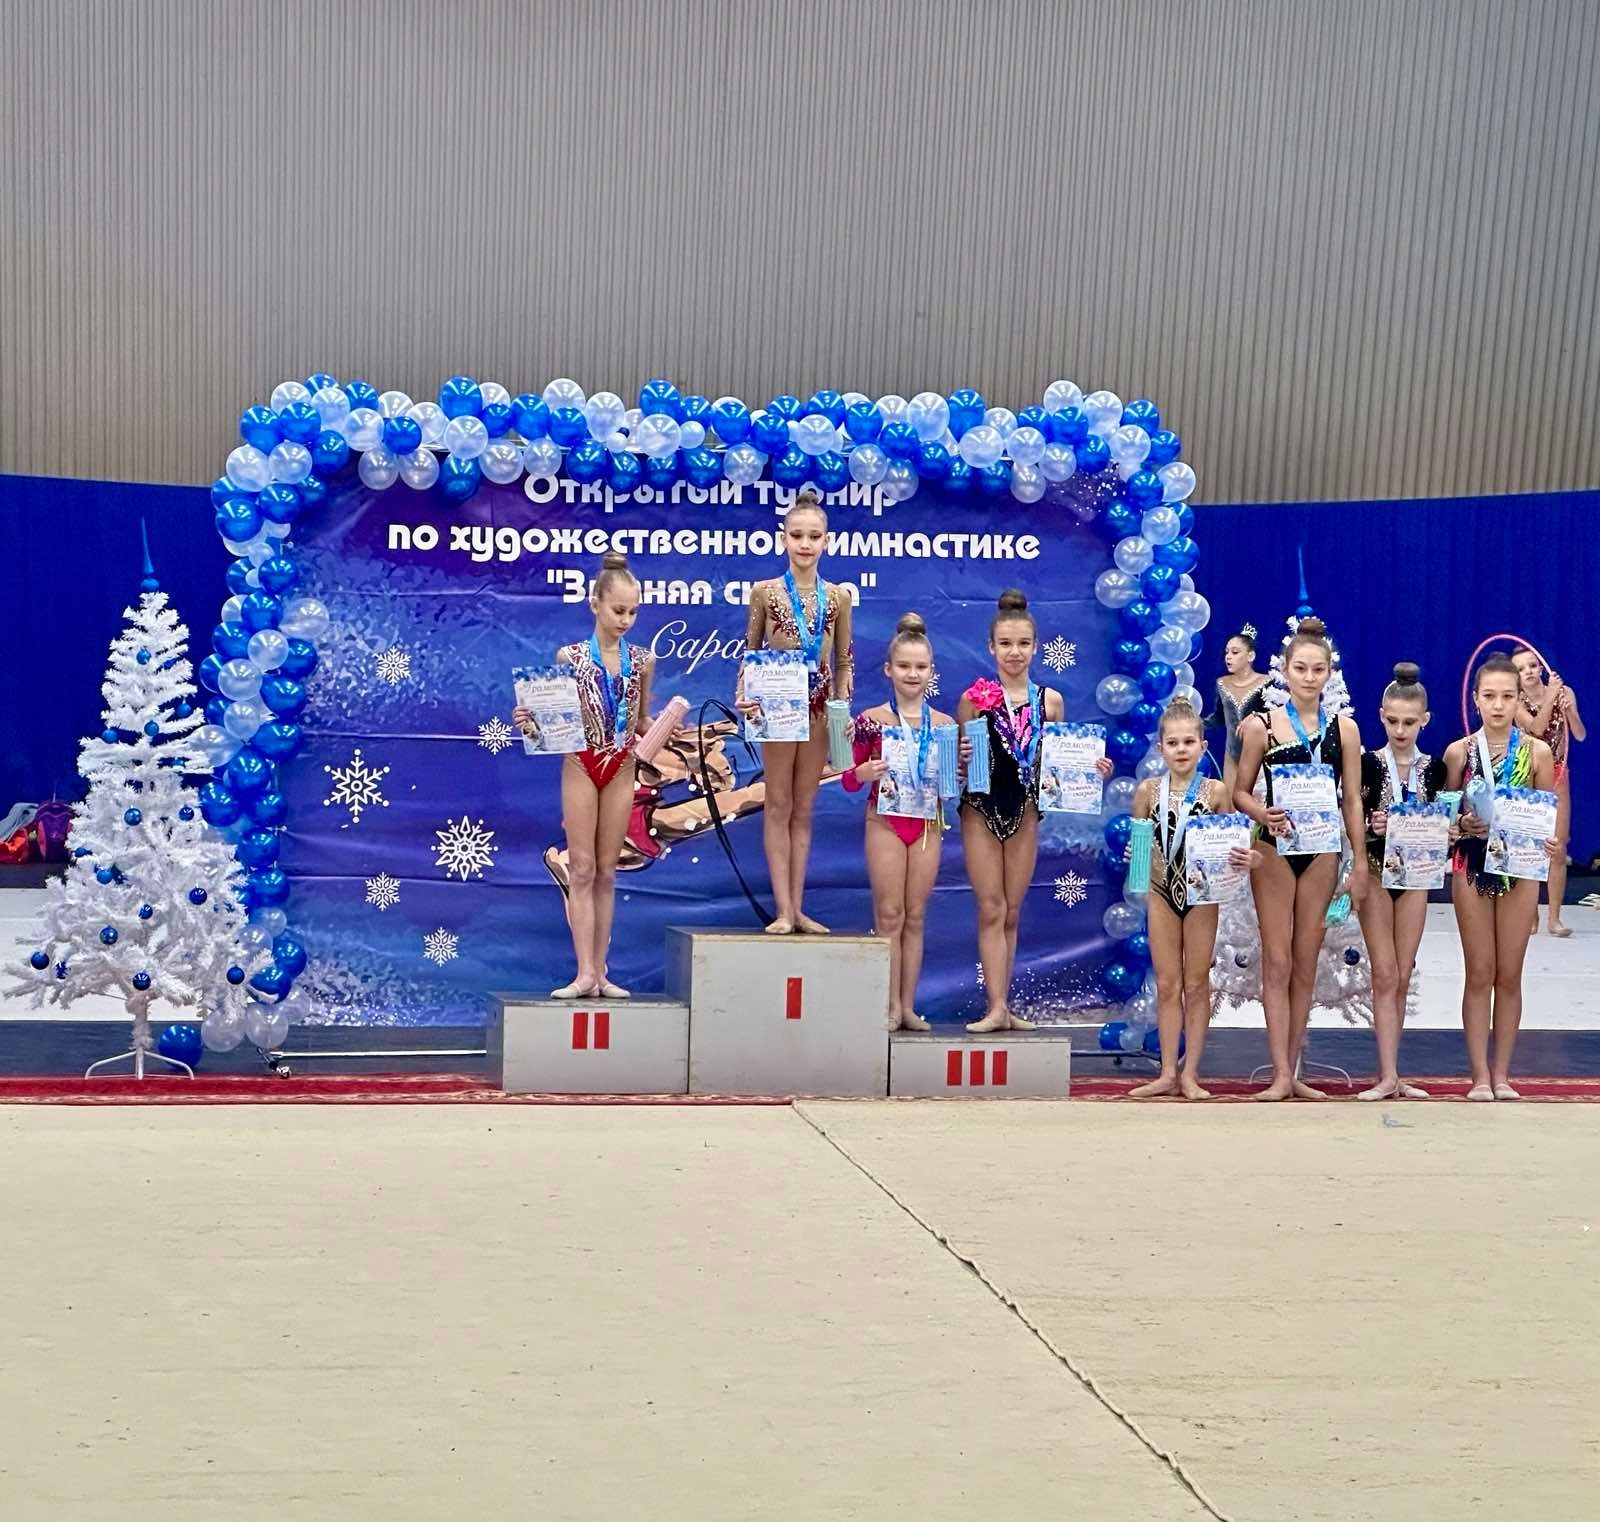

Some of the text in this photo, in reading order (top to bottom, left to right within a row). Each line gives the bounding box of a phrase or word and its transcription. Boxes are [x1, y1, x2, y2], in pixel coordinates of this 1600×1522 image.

[388, 524, 440, 551] по
[826, 531, 1041, 560] имнастике
[547, 569, 712, 605] "Зняя
[572, 1012, 610, 1050] II
[947, 1050, 1008, 1087] III
